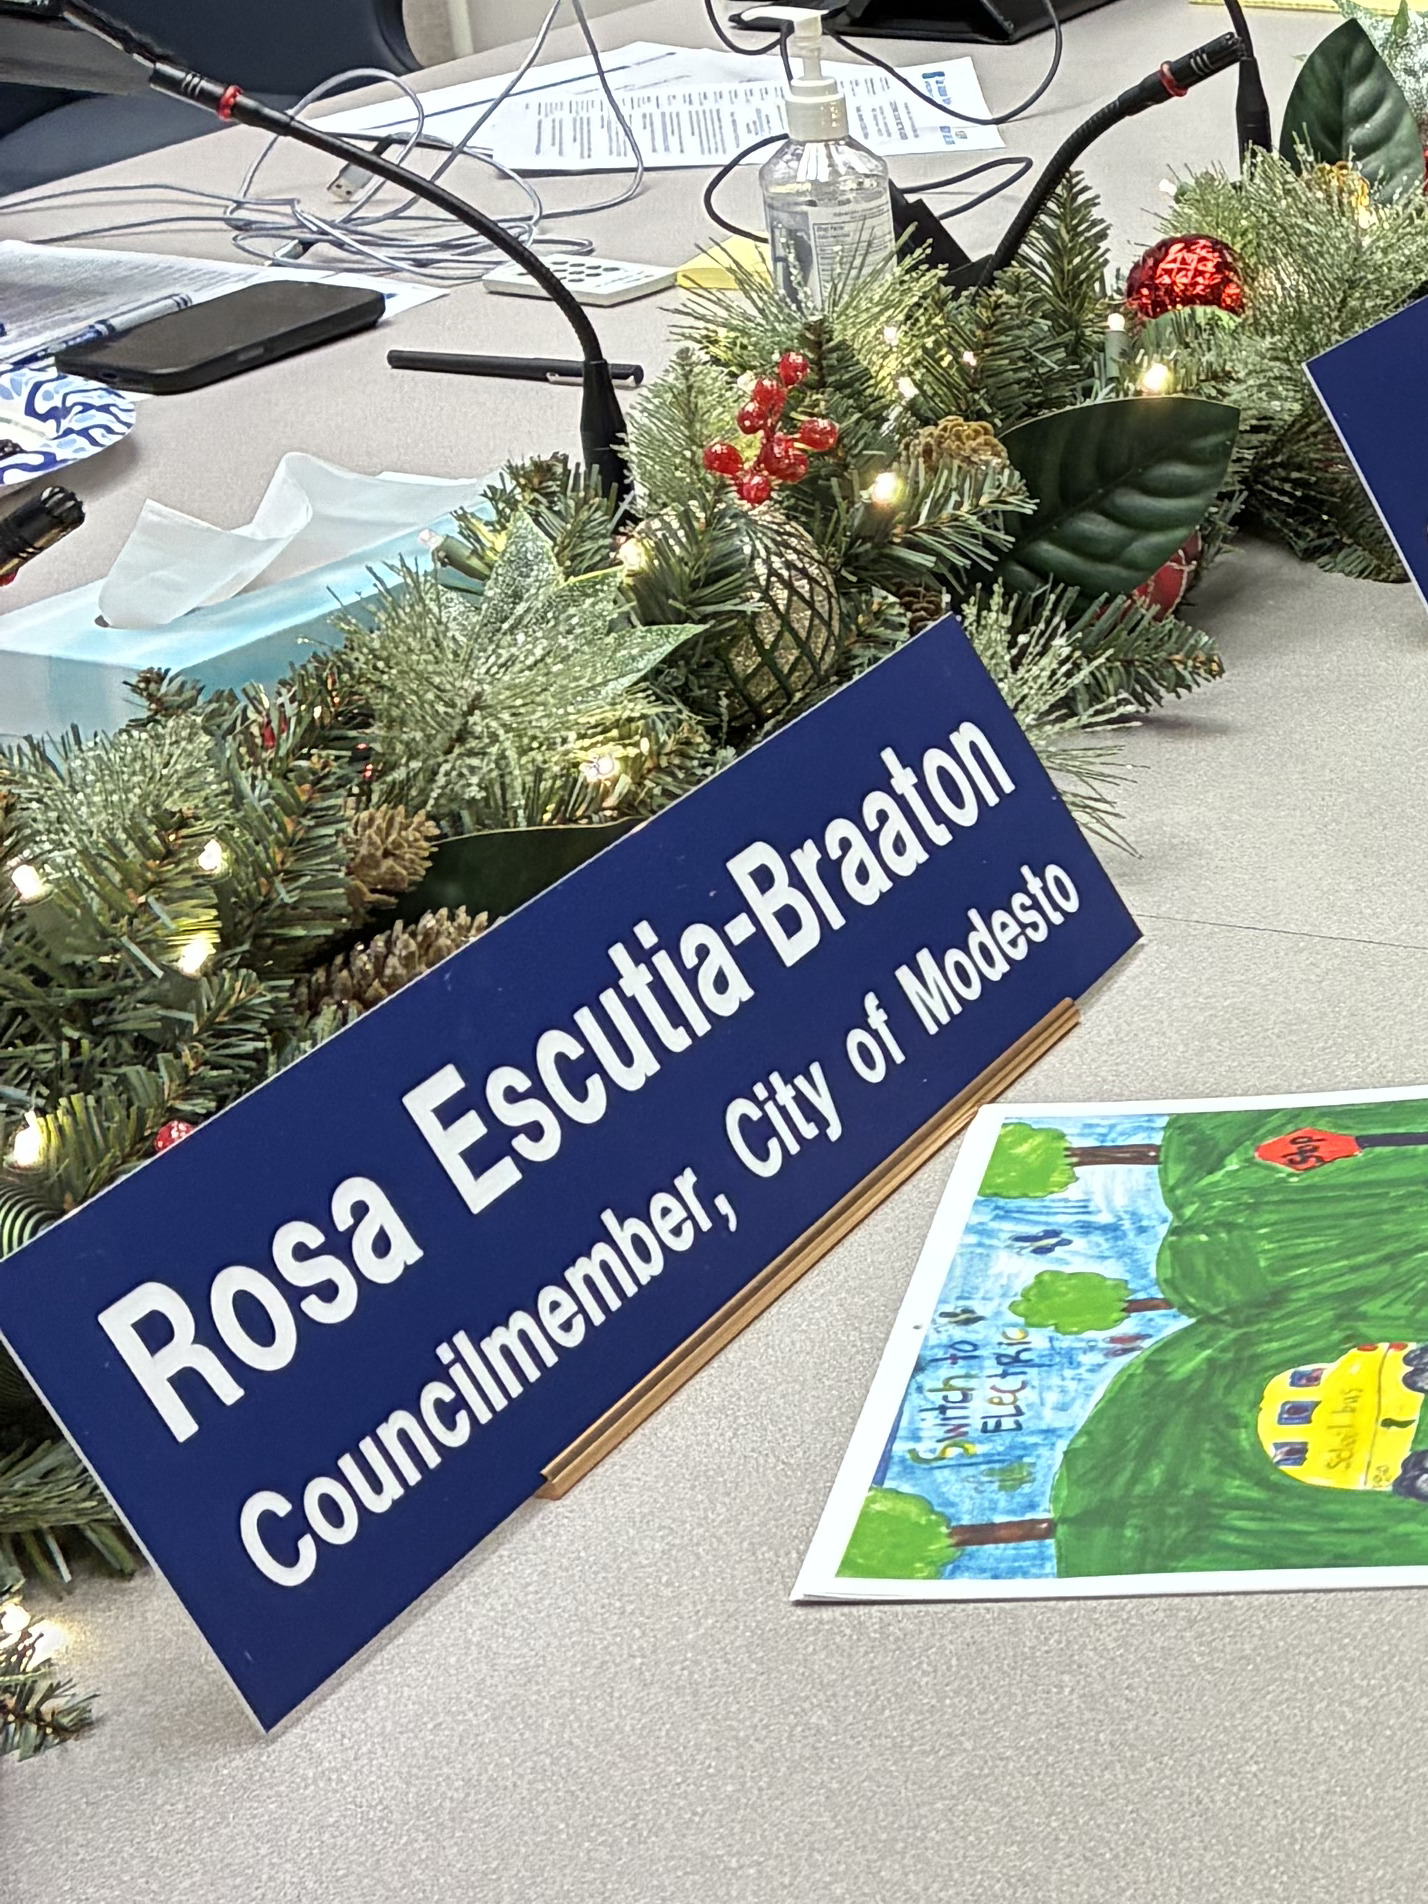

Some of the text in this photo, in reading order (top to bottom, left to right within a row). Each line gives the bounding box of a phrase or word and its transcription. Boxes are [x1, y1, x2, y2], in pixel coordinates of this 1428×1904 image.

[97, 721, 1016, 1443] Rosa Escutia-Braaton
[240, 863, 1080, 1587] Councilmember, City of Modesto
[908, 1340, 981, 1465] Switch to
